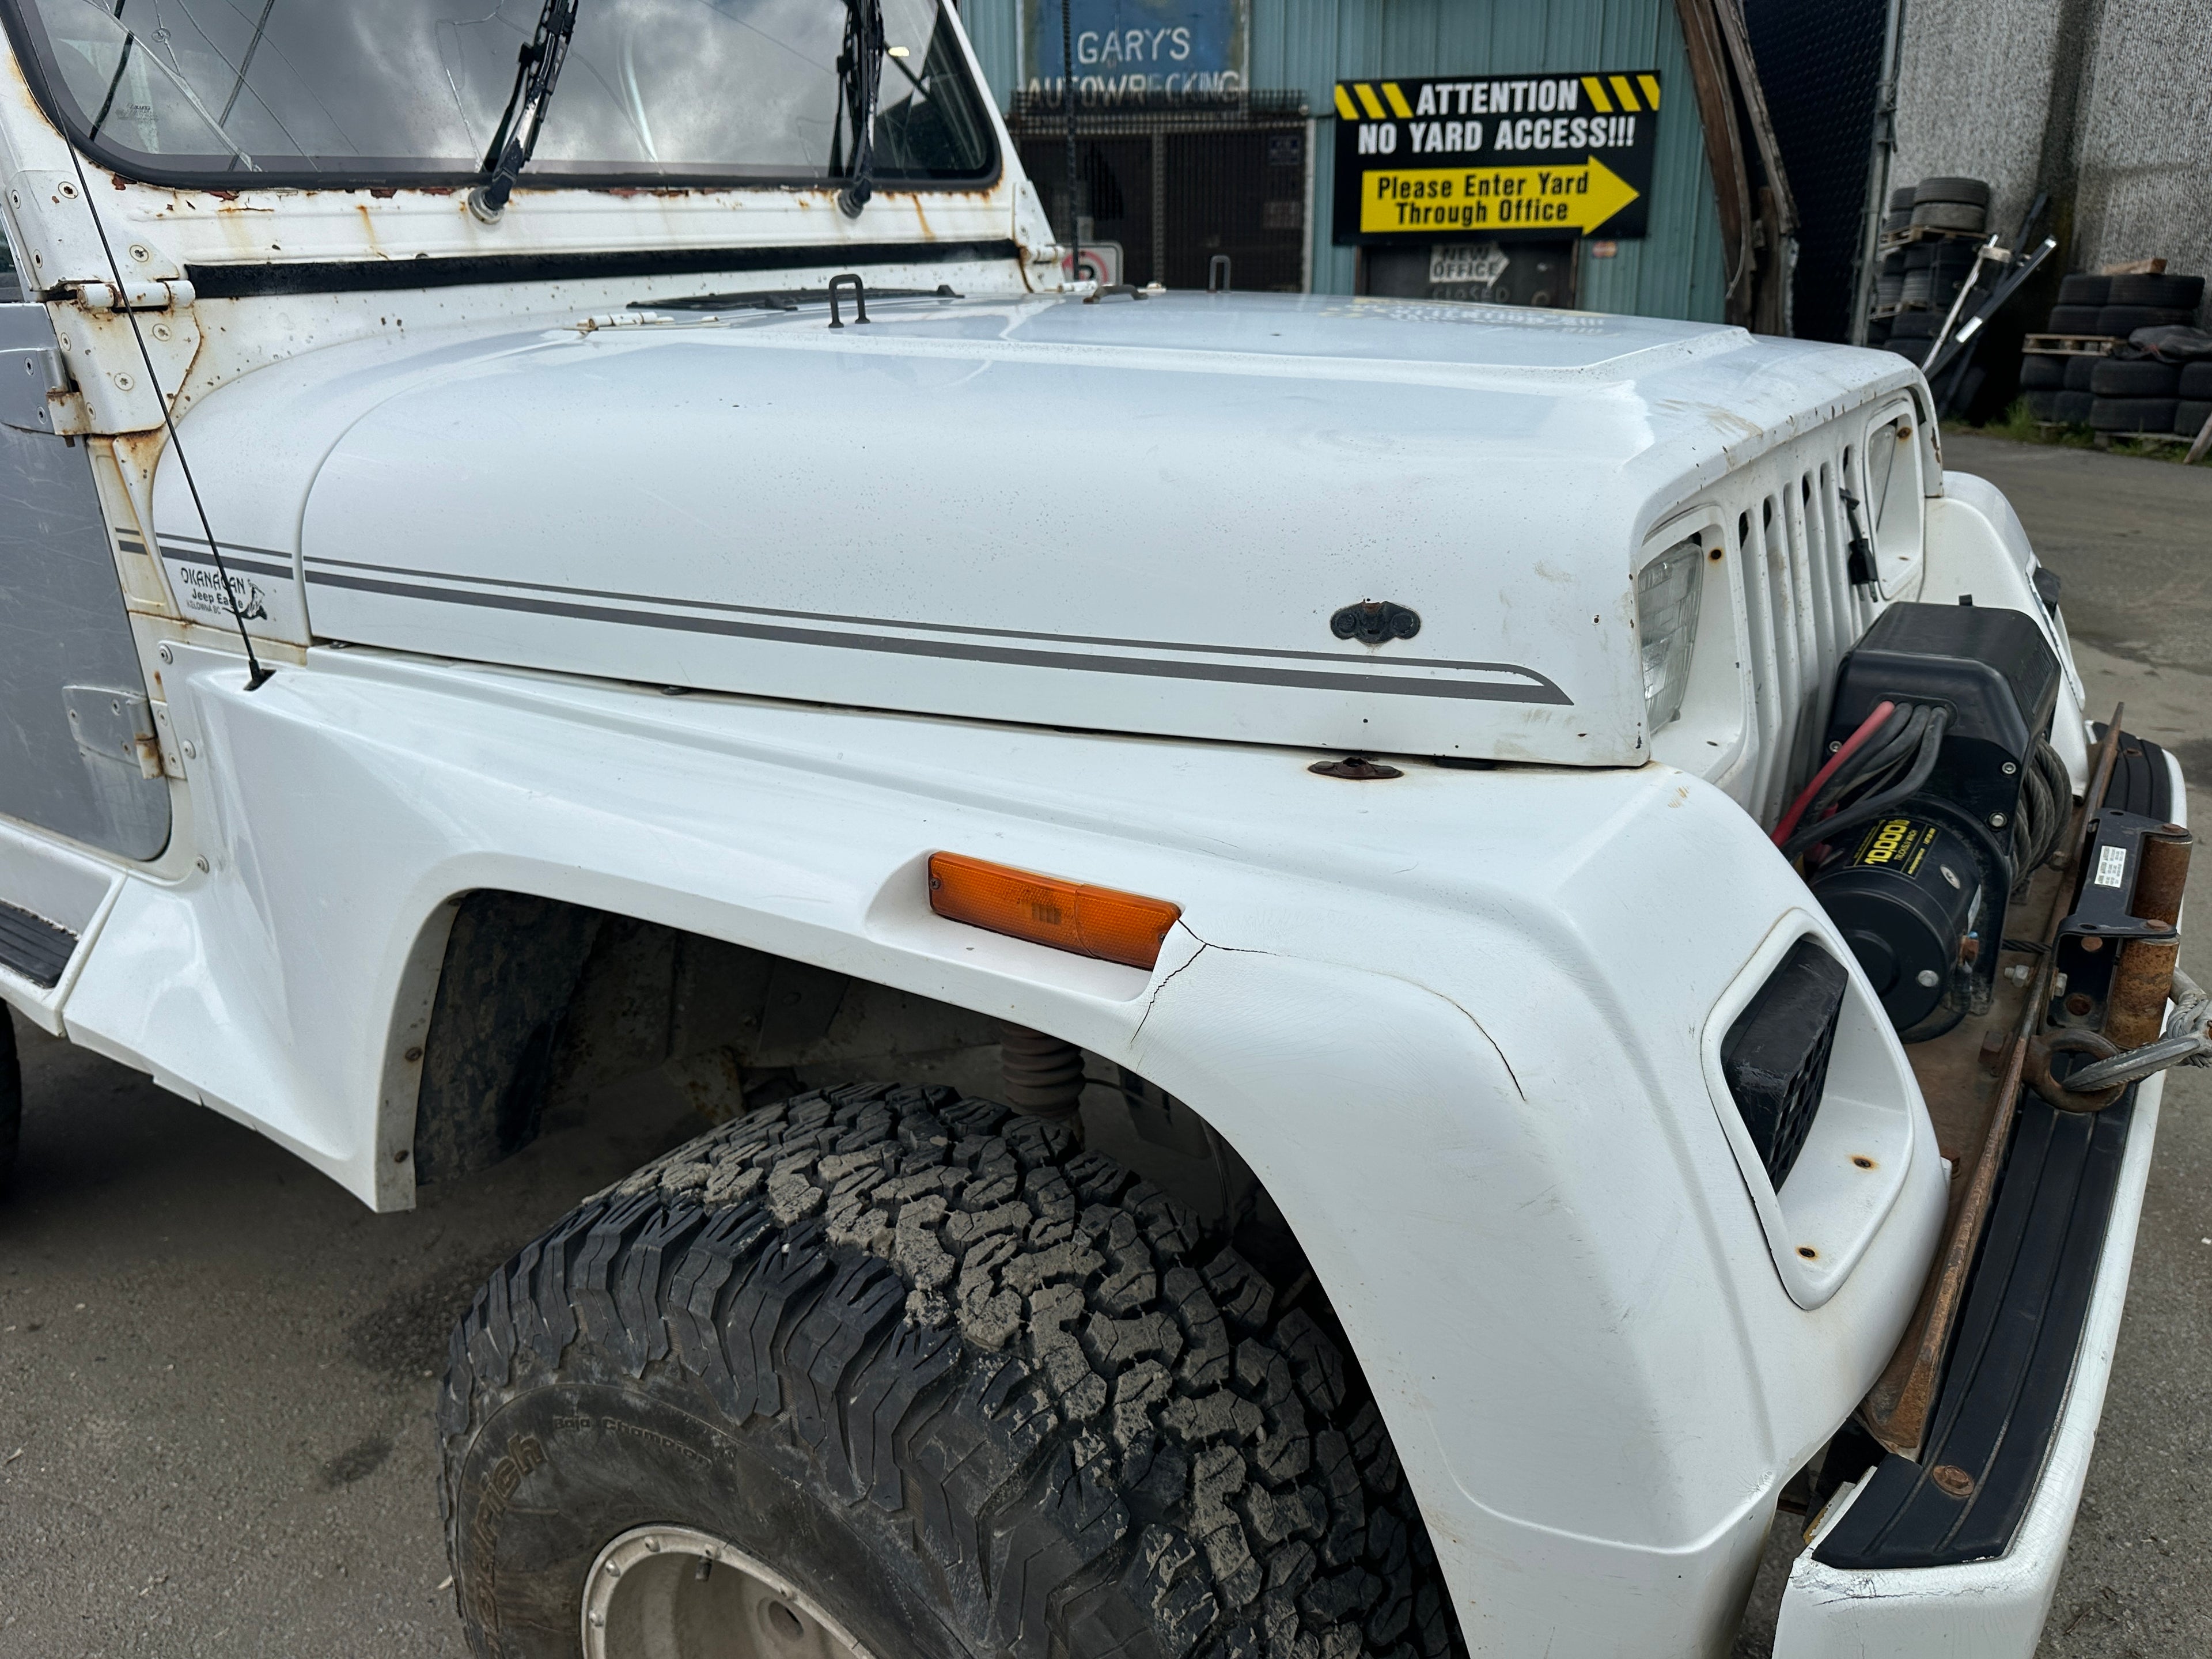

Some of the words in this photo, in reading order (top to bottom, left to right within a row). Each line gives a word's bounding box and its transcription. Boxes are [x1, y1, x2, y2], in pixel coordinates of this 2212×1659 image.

[1078, 26, 1191, 64] GARY'S
[1416, 79, 1578, 116] ATTENTION
[1358, 123, 1397, 154] NO
[1409, 121, 1483, 153] YARD
[1494, 116, 1635, 150] ACCESS!!!
[1377, 176, 1452, 200] Please
[1464, 175, 1526, 197] Enter
[1537, 172, 1589, 196] Yard
[1396, 201, 1487, 226] Through
[1498, 200, 1569, 222] Office
[1442, 246, 1489, 261] NEW
[1433, 261, 1498, 277] OFFICE
[192, 588, 214, 604] Jeep
[217, 593, 244, 609] Eae
[552, 1414, 592, 1431] Baja
[601, 1414, 713, 1467] Champion
